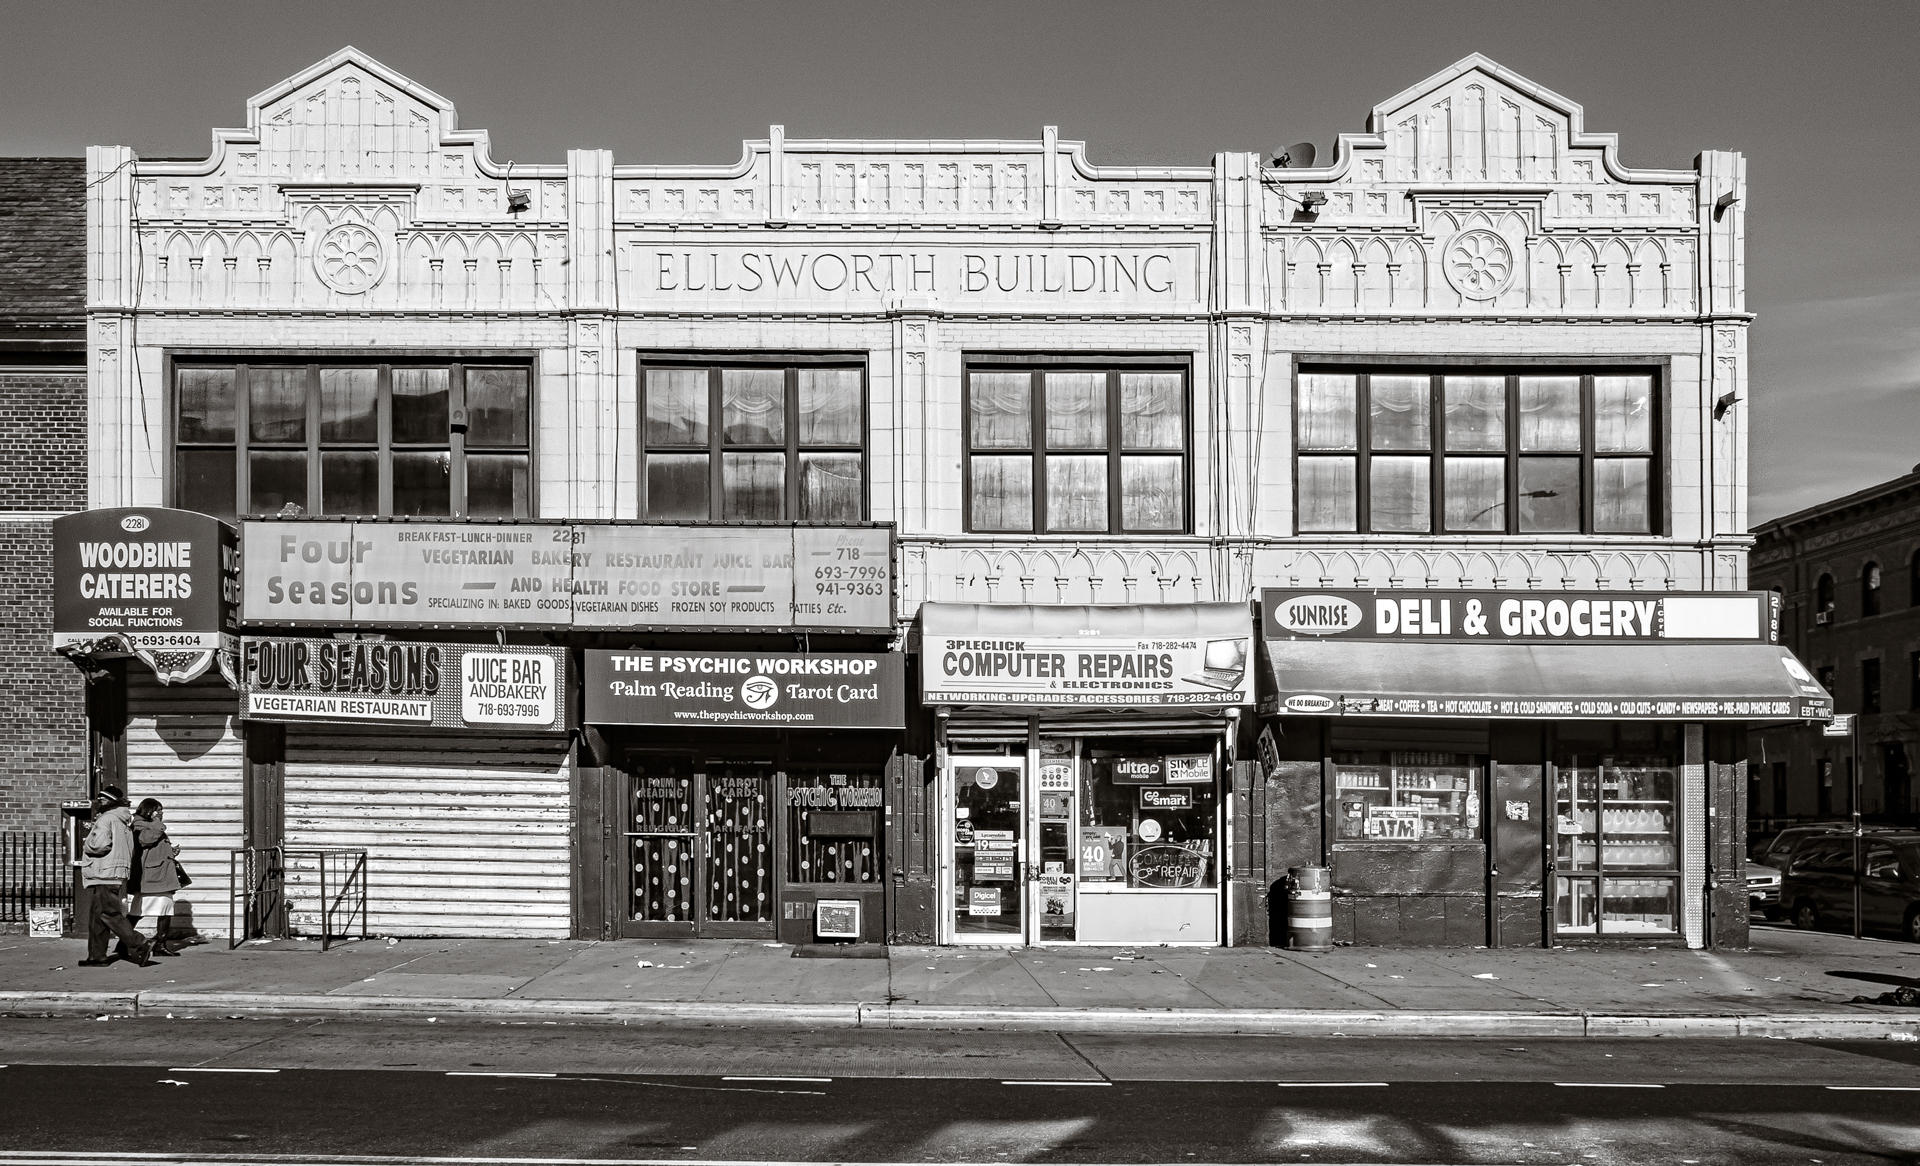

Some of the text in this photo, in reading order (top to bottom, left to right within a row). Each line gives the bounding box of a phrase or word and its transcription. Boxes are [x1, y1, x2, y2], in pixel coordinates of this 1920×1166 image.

[656, 254, 1174, 294] ELLSWORTH BUILDING
[125, 519, 145, 530] 2281
[553, 529, 586, 544] 2281
[79, 542, 192, 568] WOODBINE
[280, 535, 373, 563] Four
[837, 548, 860, 560] 718
[423, 550, 793, 569] VEGETARIAN BAKERY RESTAURANT JUICE BAR
[815, 566, 886, 579] 693-7996
[80, 573, 192, 599] CATERERS
[267, 576, 418, 604] Seasons
[511, 577, 720, 596] AND HEALTH FOOD STORE
[816, 583, 883, 595] 941-9363
[98, 607, 172, 616] AVAILABLE FOR
[428, 597, 484, 609] SPECIALIZING
[504, 598, 531, 609] BAKED
[576, 601, 627, 612] VEGETARIAN
[631, 601, 658, 613] DISHES
[671, 602, 705, 613] FROZEN
[709, 602, 727, 613] SOY
[731, 602, 775, 613] PRODUCTS
[789, 602, 822, 613] PATTIES
[88, 617, 183, 627] SOCIAL FUNCTIONS
[1289, 605, 1348, 626] SUNRISE
[1375, 599, 1452, 635] DELI
[1465, 599, 1489, 635] &
[1500, 599, 1656, 636] GROCERY
[946, 640, 1197, 651] 3PLECLICK Fax 718-282-4474
[243, 641, 440, 695] FOUR SEASONS
[468, 658, 541, 684] JUICE BAR
[611, 656, 877, 675] THE PSYCHIC WORKSHOP
[942, 653, 1173, 678] COMPUTER REPAIRS
[609, 681, 878, 703] Palm Reading Tarot Card
[1050, 681, 1173, 690] & ELECTRONICS
[927, 692, 1241, 704] NETWORKING UPGRADES ACCESSORIES 718-282-4160
[1304, 699, 1331, 707] BREAKFAST
[254, 697, 427, 717] VEGETARIAN RESTAURANT
[478, 703, 540, 717] 718-693-7996
[1399, 700, 1420, 712] COFFEE
[1427, 701, 1438, 712] TEA
[1445, 701, 1458, 713] HOT
[1458, 701, 1491, 713] CHOCOLATE
[1501, 702, 1513, 713] HOT
[1519, 702, 1536, 714] COLD
[1536, 702, 1573, 714] SANDWICHES
[1580, 702, 1596, 714] COLD
[1596, 702, 1613, 714] SODA
[1620, 702, 1636, 714] COLD
[1636, 702, 1651, 714] CUTS
[1656, 702, 1676, 714] CANDY
[1682, 702, 1718, 714] NEWSPAPERS
[1723, 702, 1750, 714] PRE-PAID
[1750, 702, 1771, 714] PHONE
[1771, 702, 1790, 714] CARDS
[1801, 706, 1832, 717] EBT WIC
[674, 711, 814, 721] www.thepsychicworkshop.com
[1117, 761, 1148, 774] ultra
[1170, 759, 1208, 769] SIMPLE
[829, 774, 847, 786] THE
[1180, 769, 1209, 779] Mobile
[722, 778, 758, 788] TAROT
[639, 788, 683, 799] READING
[721, 788, 759, 798] CARDS
[787, 787, 834, 807] PSYCHIC
[1153, 796, 1186, 806] smart
[1160, 864, 1200, 879] REPAIR
[974, 891, 996, 901] Digicel
